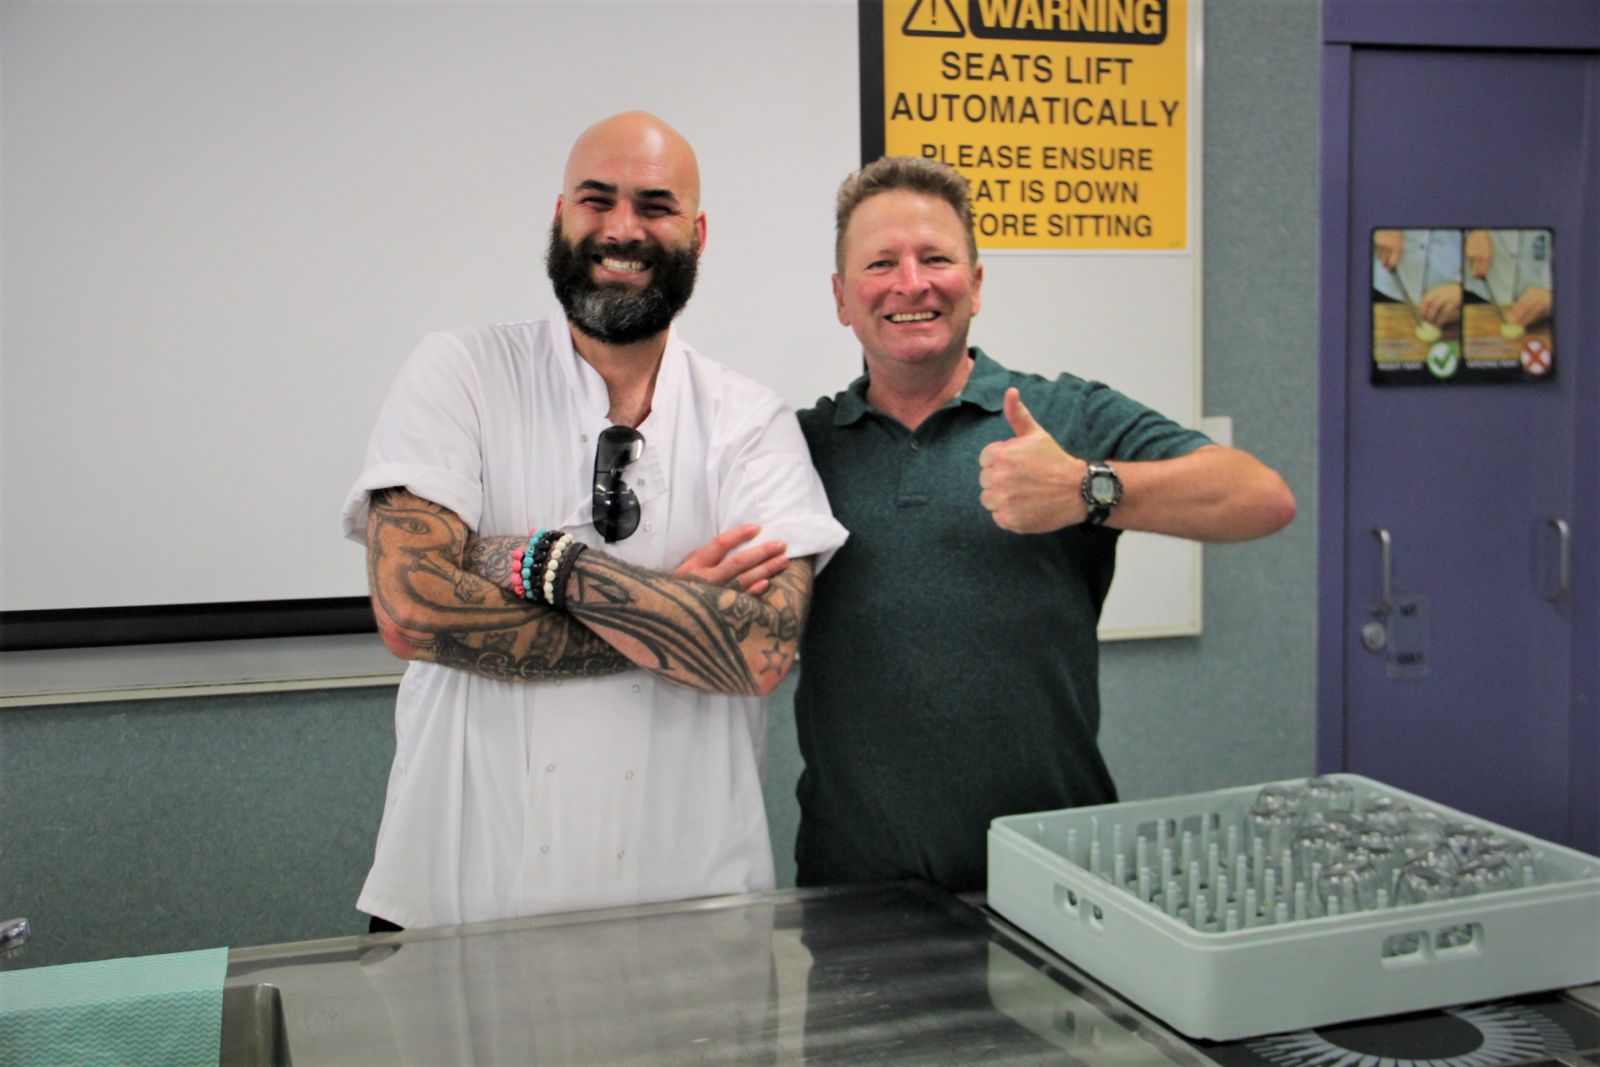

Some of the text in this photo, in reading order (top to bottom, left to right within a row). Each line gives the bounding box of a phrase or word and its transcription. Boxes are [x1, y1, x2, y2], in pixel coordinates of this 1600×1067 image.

[979, 0, 1162, 35] WARNING
[941, 51, 1133, 85] SEATS LIFT
[890, 92, 1179, 127] AUTOMATICALLY
[1042, 146, 1153, 171] ENSURE
[1020, 180, 1044, 203] IS
[1055, 181, 1138, 204] DOWN
[1047, 214, 1152, 237] SITTING
